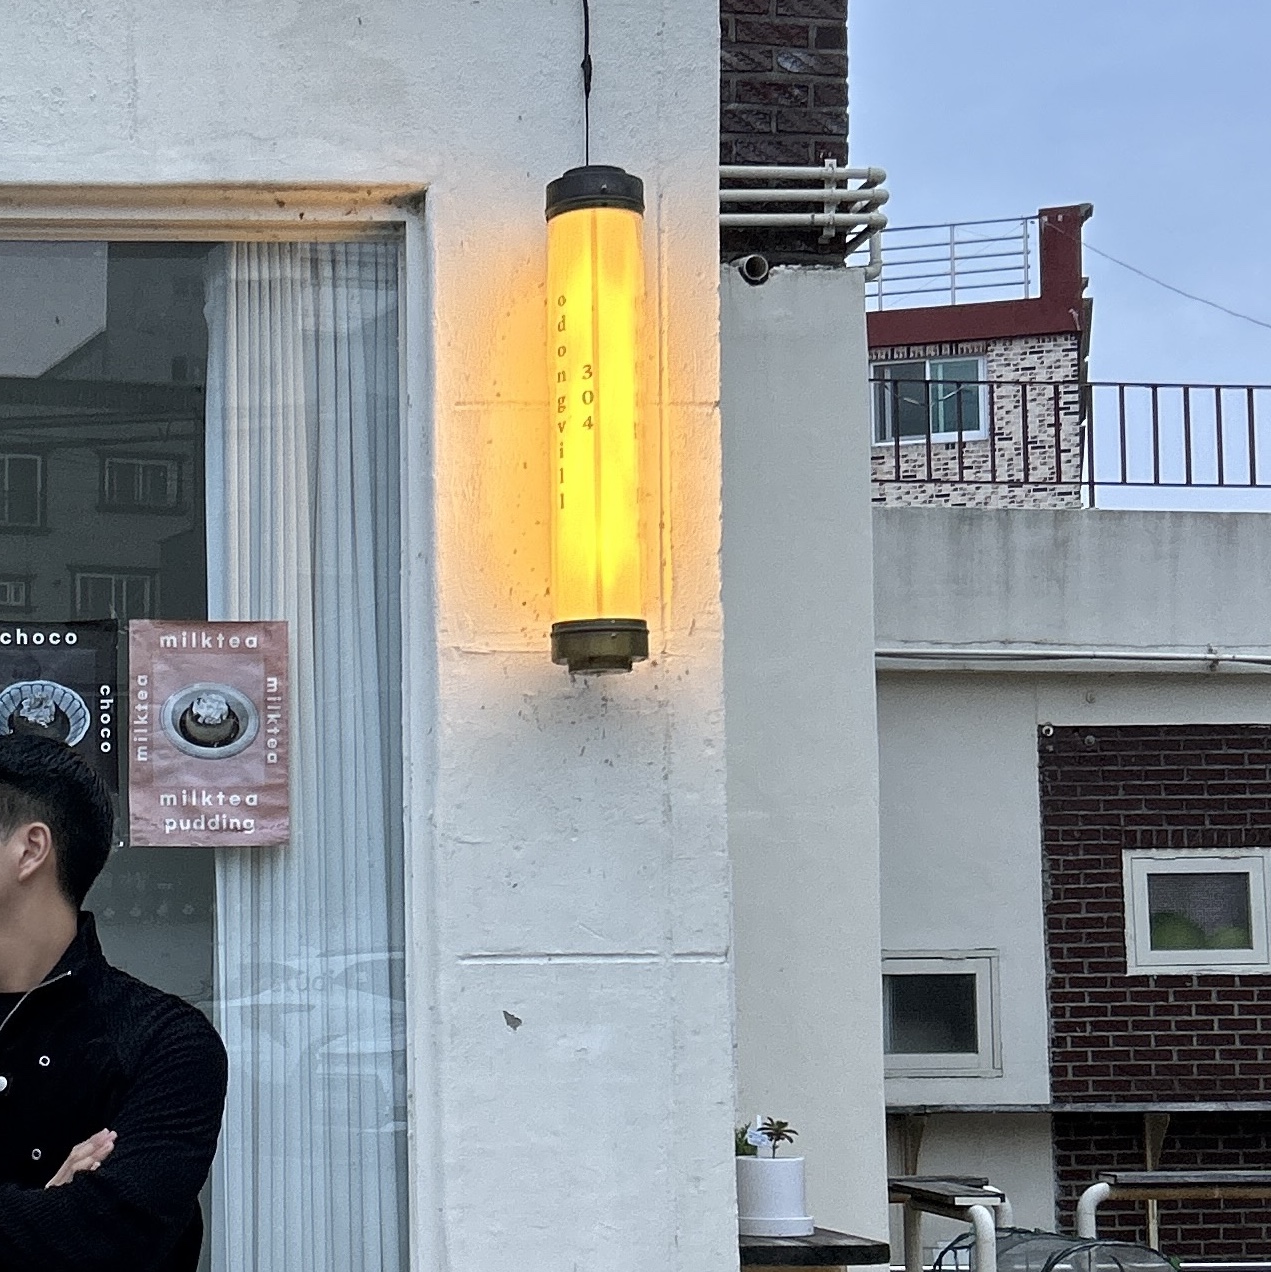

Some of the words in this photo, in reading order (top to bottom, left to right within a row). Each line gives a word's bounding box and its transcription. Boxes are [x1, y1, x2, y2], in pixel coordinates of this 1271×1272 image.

[557, 295, 567, 509] odongvill
[581, 364, 595, 430] 304
[0, 628, 78, 645] choco
[159, 631, 258, 649] milktea
[99, 684, 114, 753] choco
[134, 674, 148, 762] milktea
[266, 676, 281, 765] milktea
[159, 789, 258, 807] milktea
[164, 814, 256, 834] pudding
